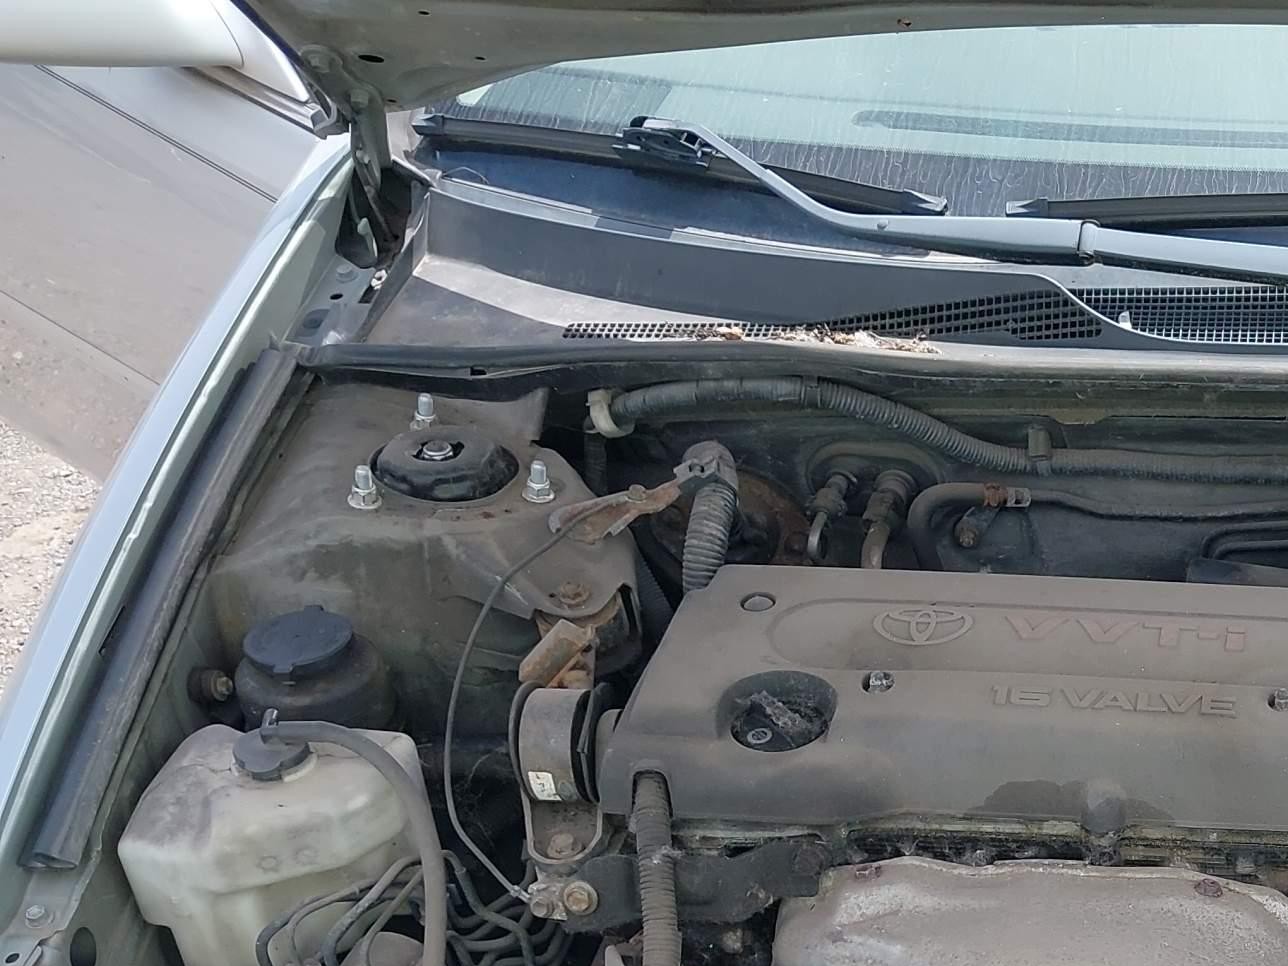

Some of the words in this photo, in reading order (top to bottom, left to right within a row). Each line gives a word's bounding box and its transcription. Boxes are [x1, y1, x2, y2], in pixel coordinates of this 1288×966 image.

[1006, 615, 1249, 652] VVT-i
[991, 684, 1050, 706] 16
[1060, 687, 1238, 717] VALVE
